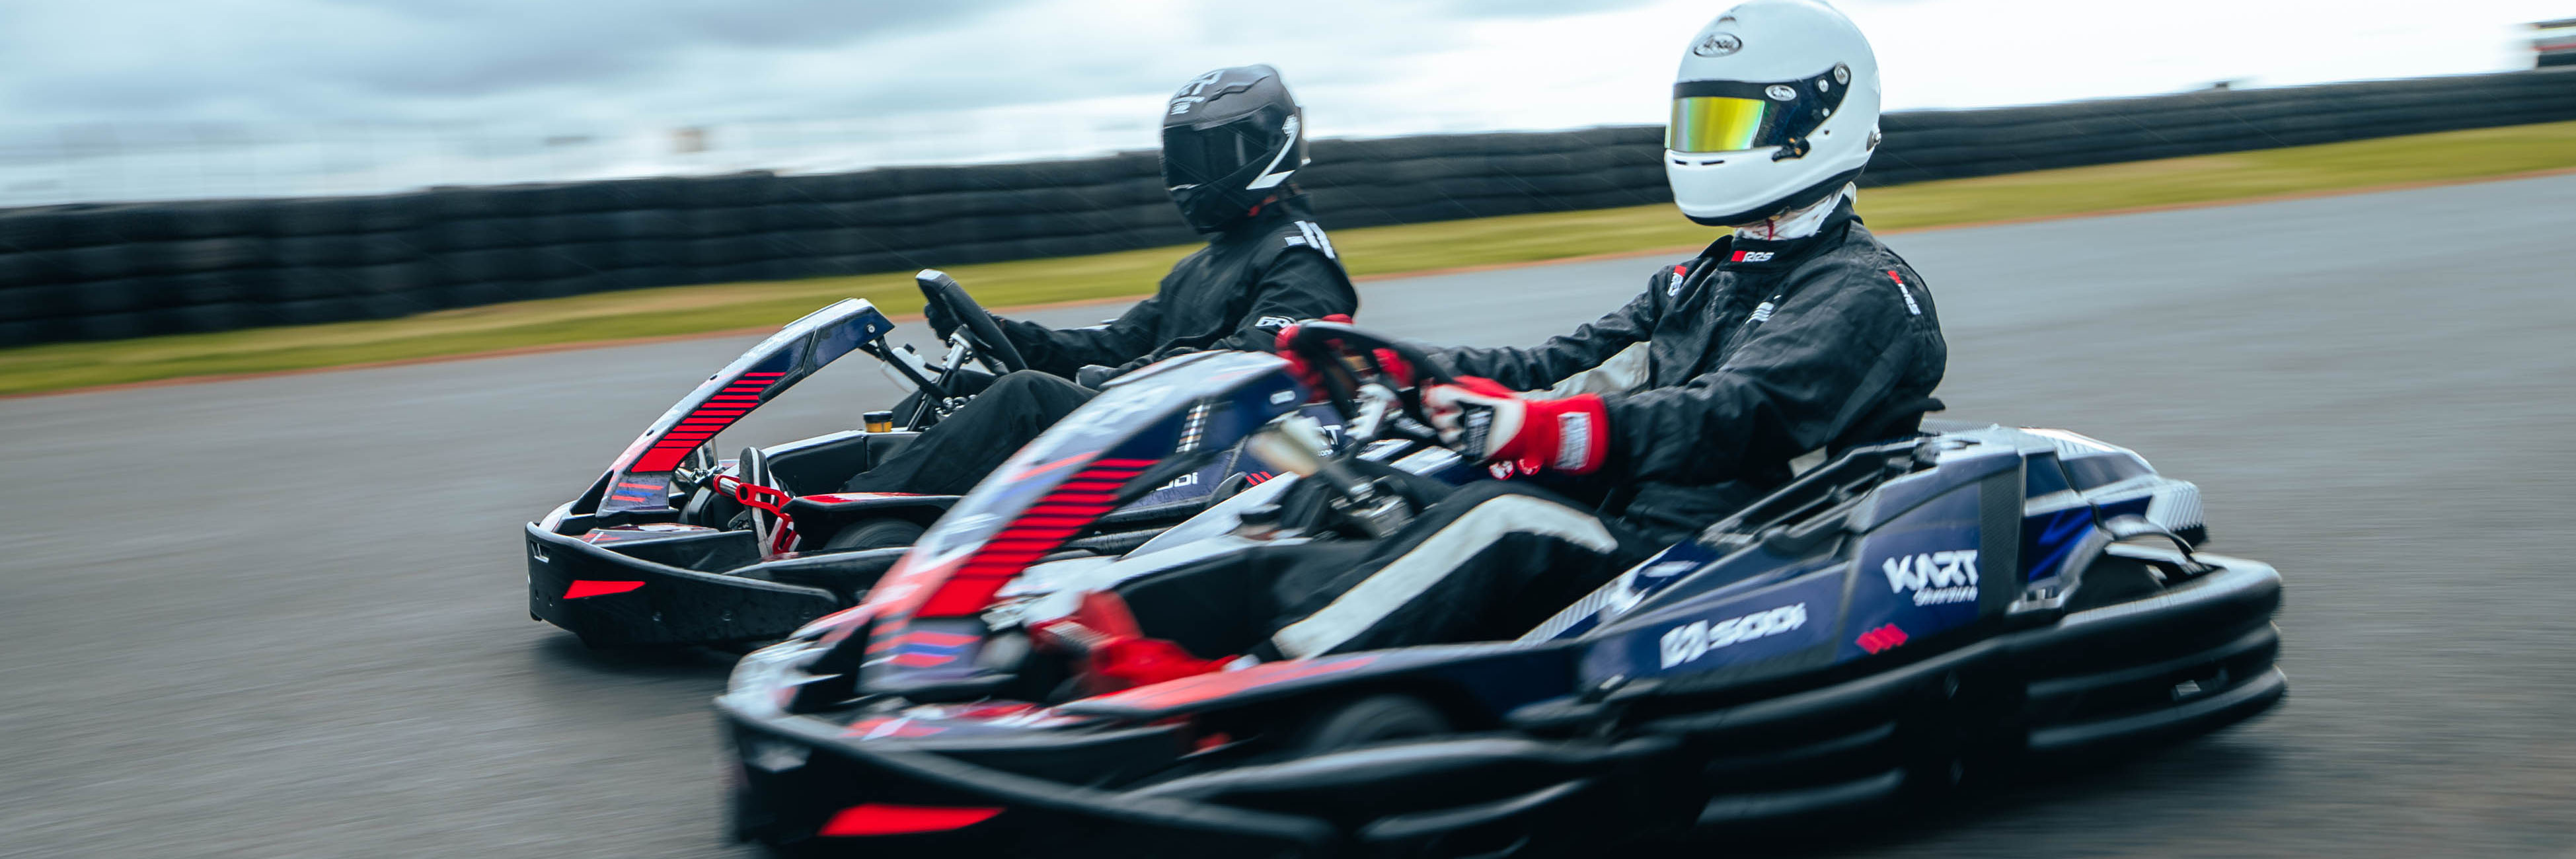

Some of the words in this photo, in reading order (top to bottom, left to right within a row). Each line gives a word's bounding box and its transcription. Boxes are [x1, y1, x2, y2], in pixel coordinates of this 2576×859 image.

[1742, 249, 1774, 262] RRS
[1882, 549, 1979, 594] KART
[1708, 602, 1807, 650] SODI
